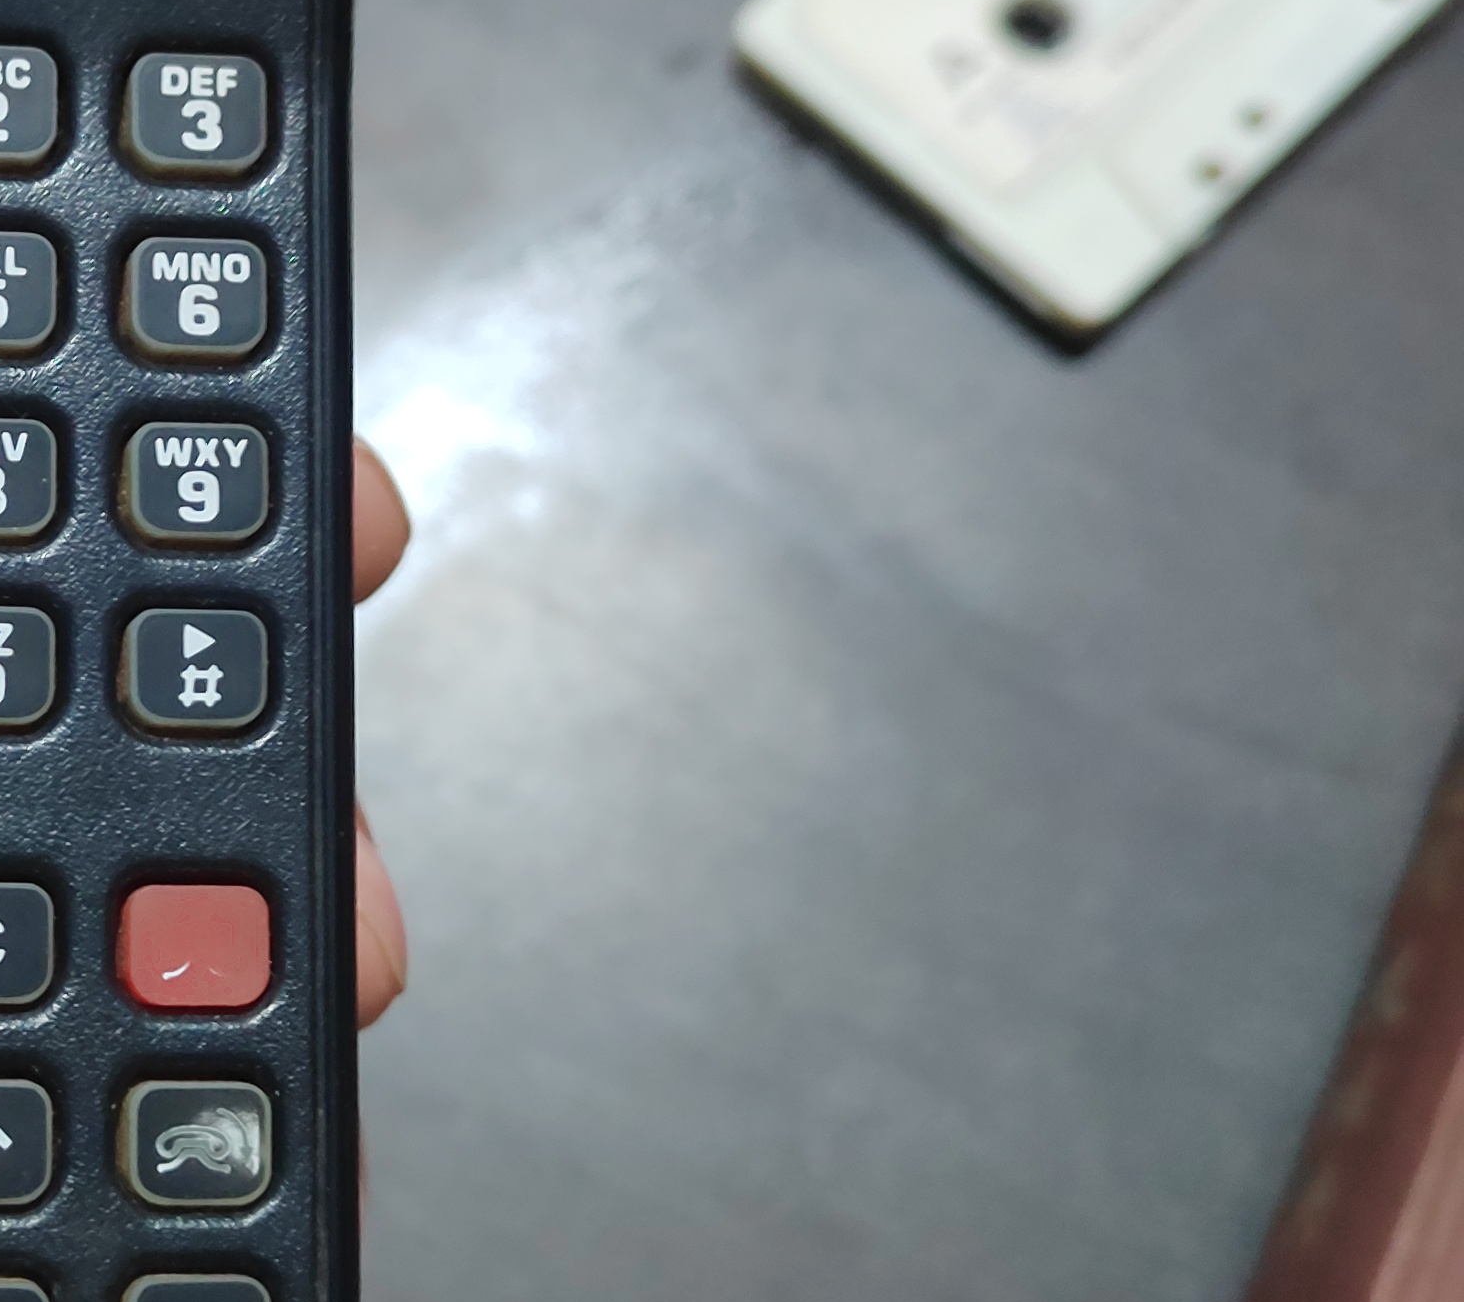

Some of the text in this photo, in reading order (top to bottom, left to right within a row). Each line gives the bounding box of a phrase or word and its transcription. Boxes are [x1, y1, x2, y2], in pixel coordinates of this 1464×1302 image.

[160, 64, 238, 98] DEF
[181, 98, 223, 152] 3
[152, 251, 251, 284] MNO
[178, 283, 221, 336] 6
[154, 436, 248, 468] WXY
[177, 470, 220, 523] 9
